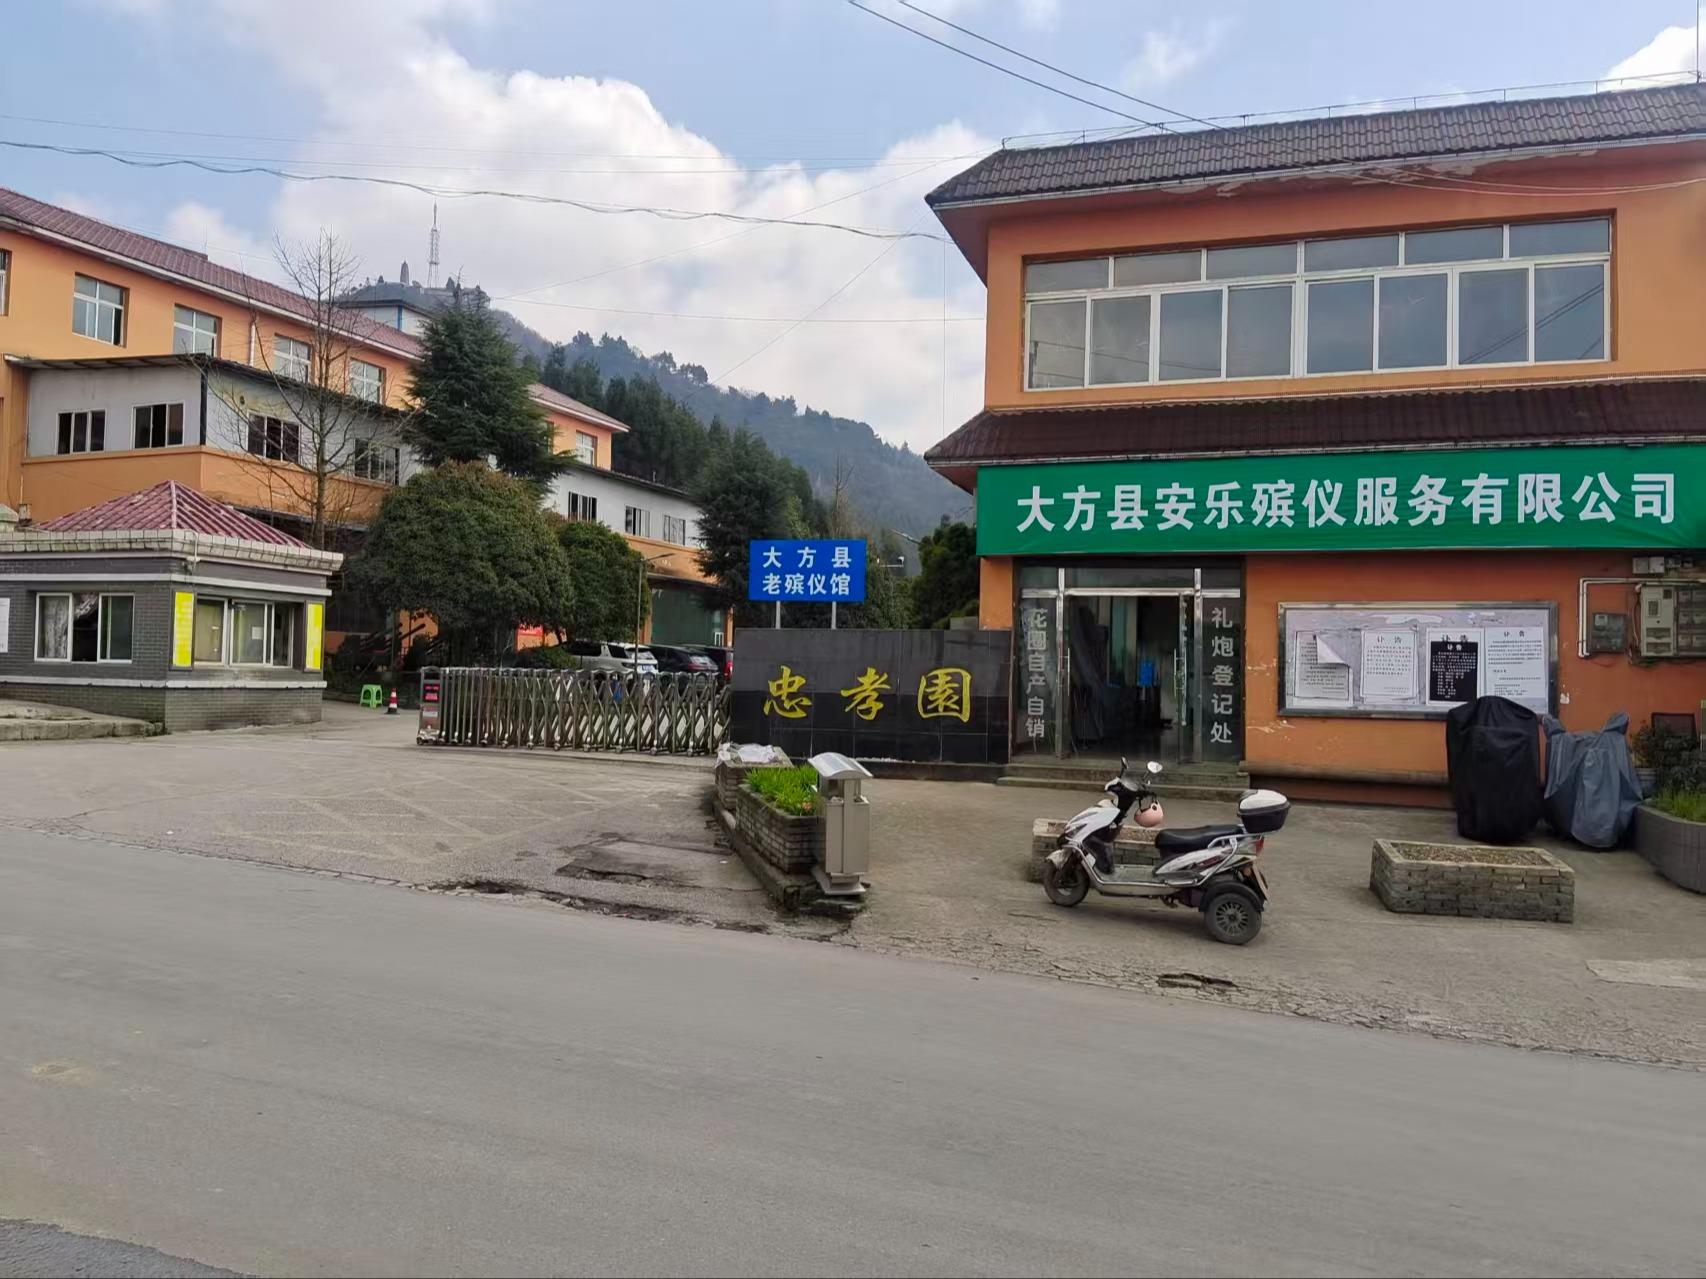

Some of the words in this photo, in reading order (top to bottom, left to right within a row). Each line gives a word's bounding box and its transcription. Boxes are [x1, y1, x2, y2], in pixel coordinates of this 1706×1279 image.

[1017, 473, 1676, 532] 大方县安乐殡仪服务有限公司
[762, 546, 852, 568] 大方县
[762, 573, 851, 596] 老殡仪馆
[763, 665, 971, 722] 忠孝園
[1026, 607, 1047, 738] 花圈自产自销
[1211, 607, 1233, 743] 礼炮登记处
